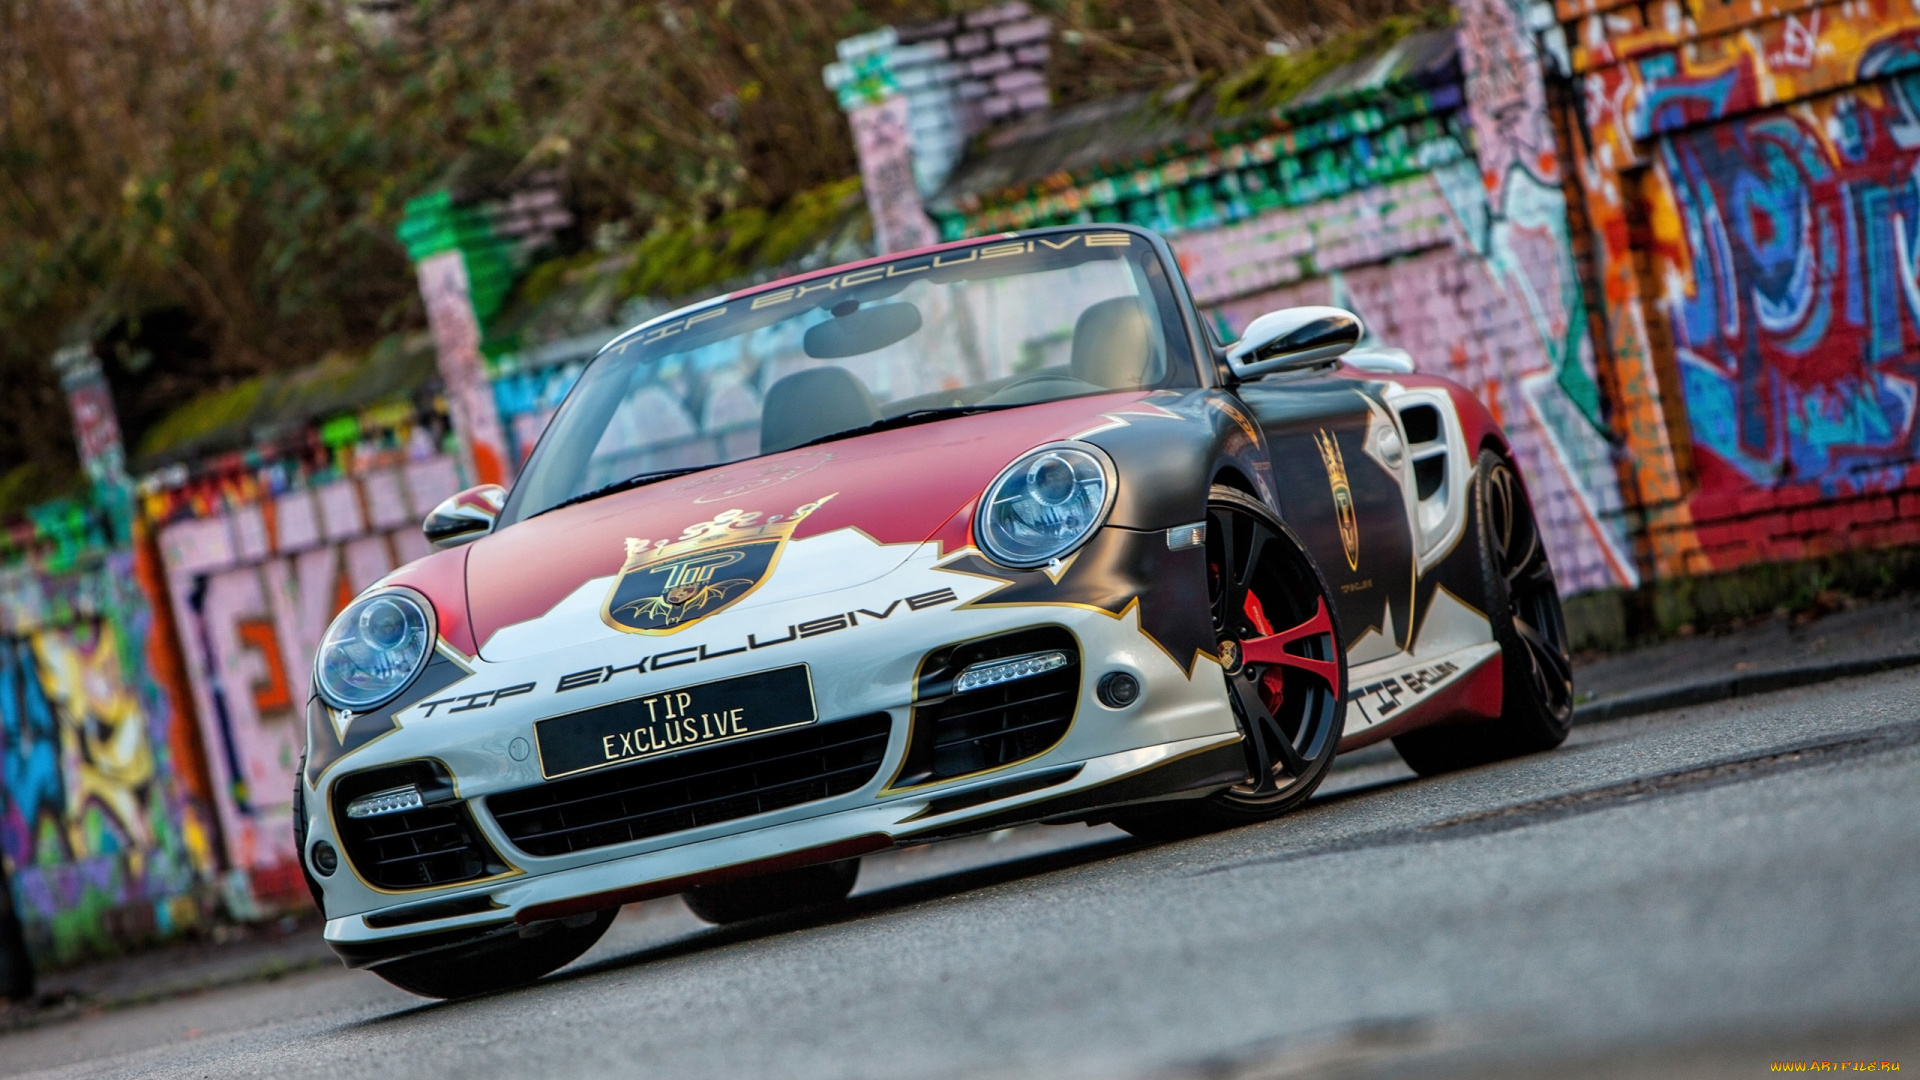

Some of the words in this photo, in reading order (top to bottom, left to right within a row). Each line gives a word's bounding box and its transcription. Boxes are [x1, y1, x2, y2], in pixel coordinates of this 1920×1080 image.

[609, 307, 727, 357] TIP
[751, 233, 1131, 310] EXCLUSIVE
[417, 681, 536, 718] TIP
[554, 587, 958, 693] EXCLUSIVE
[643, 692, 692, 723] TIP
[1347, 677, 1402, 724] TIP
[602, 708, 748, 760] EXCLUSIVE
